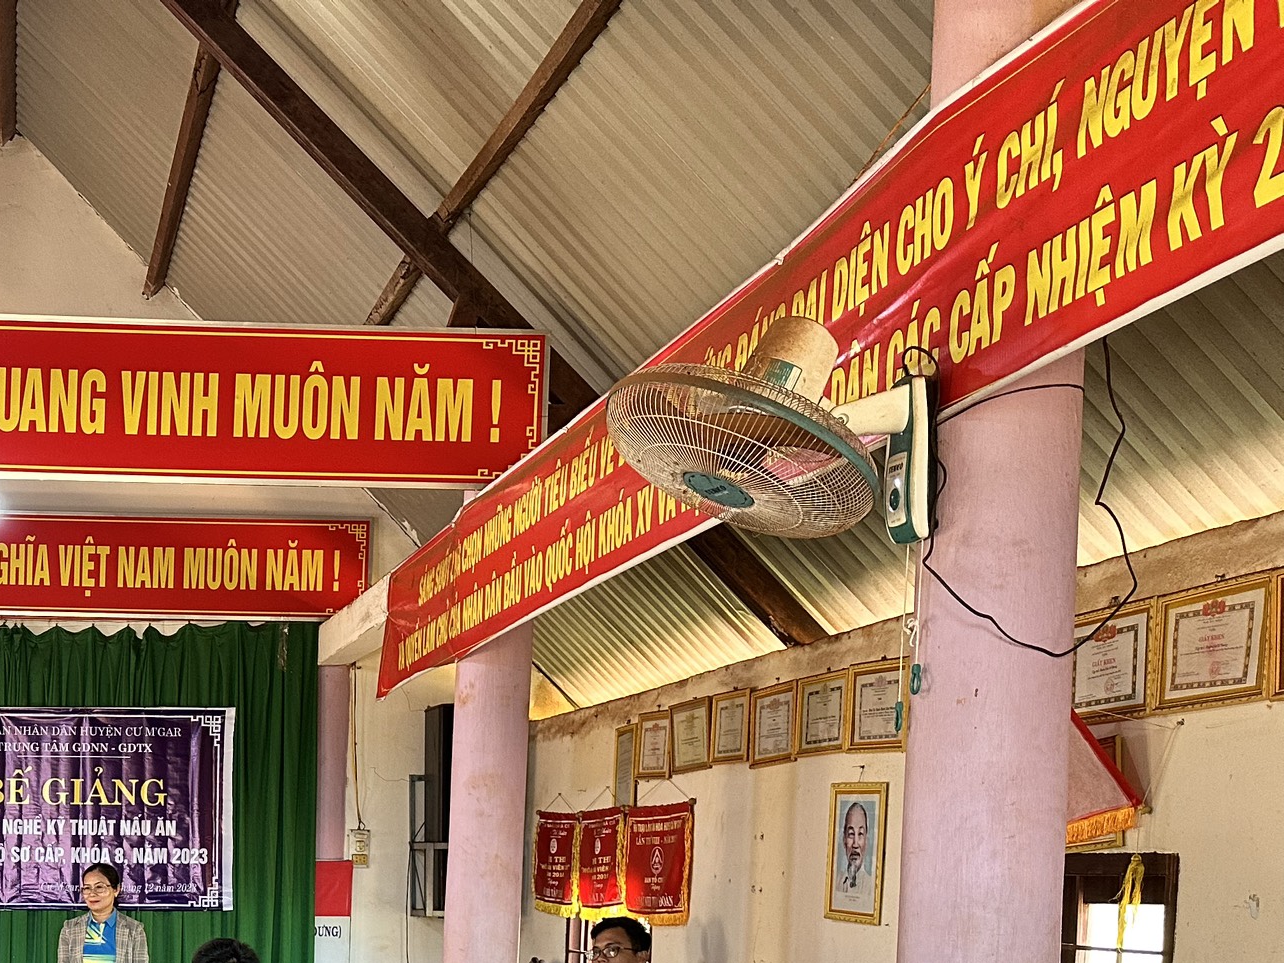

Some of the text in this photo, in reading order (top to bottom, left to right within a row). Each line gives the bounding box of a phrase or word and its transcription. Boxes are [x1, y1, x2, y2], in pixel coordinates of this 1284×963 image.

[462, 526, 483, 573] CHỌN
[483, 502, 512, 558] NHỮNG
[513, 475, 542, 538] NGƯỜI
[544, 458, 568, 517] TIÊU
[569, 425, 598, 500] BIỂU
[832, 220, 890, 322] DIỆN
[896, 176, 954, 276] CHO
[964, 134, 989, 231] Ý
[996, 78, 1067, 210] CHÍ,
[462, 581, 483, 633] NHÂN
[484, 570, 502, 621] DÂN
[503, 551, 522, 610] BẦU
[524, 545, 543, 599] VÀO
[545, 517, 573, 593] QUỐC
[575, 510, 596, 574] HỘI
[598, 488, 633, 559] KHÓA
[635, 483, 655, 538] XV
[948, 242, 1016, 364] CẤP
[1024, 184, 1157, 328] NHIỆM
[1167, 114, 1240, 252] KỲ
[121, 370, 220, 437] VINH
[233, 361, 361, 441] MUÔN
[374, 363, 474, 443] NĂM
[489, 379, 503, 443] !
[58, 536, 111, 597] VIỆT
[117, 546, 175, 589] NAM
[183, 538, 258, 591] MUÔN
[265, 539, 324, 591] NĂM
[332, 549, 341, 592] !
[14, 724, 48, 736] NHÂN
[52, 724, 77, 736] DÂN
[80, 724, 122, 739] HUYỆN
[125, 725, 144, 737] CƯ
[43, 740, 69, 752] TÂM
[72, 742, 109, 753] GDNN
[118, 742, 153, 753] GDTX
[42, 766, 167, 807] GIẢNG
[2, 814, 43, 836] NGHỀ
[47, 816, 66, 836] KỸ
[70, 816, 116, 839] THUẬT
[120, 814, 152, 836] NẤU
[155, 816, 177, 836] ĂN
[10, 845, 31, 863] SƠ
[35, 841, 66, 864] CẤP,
[71, 843, 110, 863] KHÓA
[133, 844, 167, 864] NĂM
[172, 847, 208, 864] 2023
